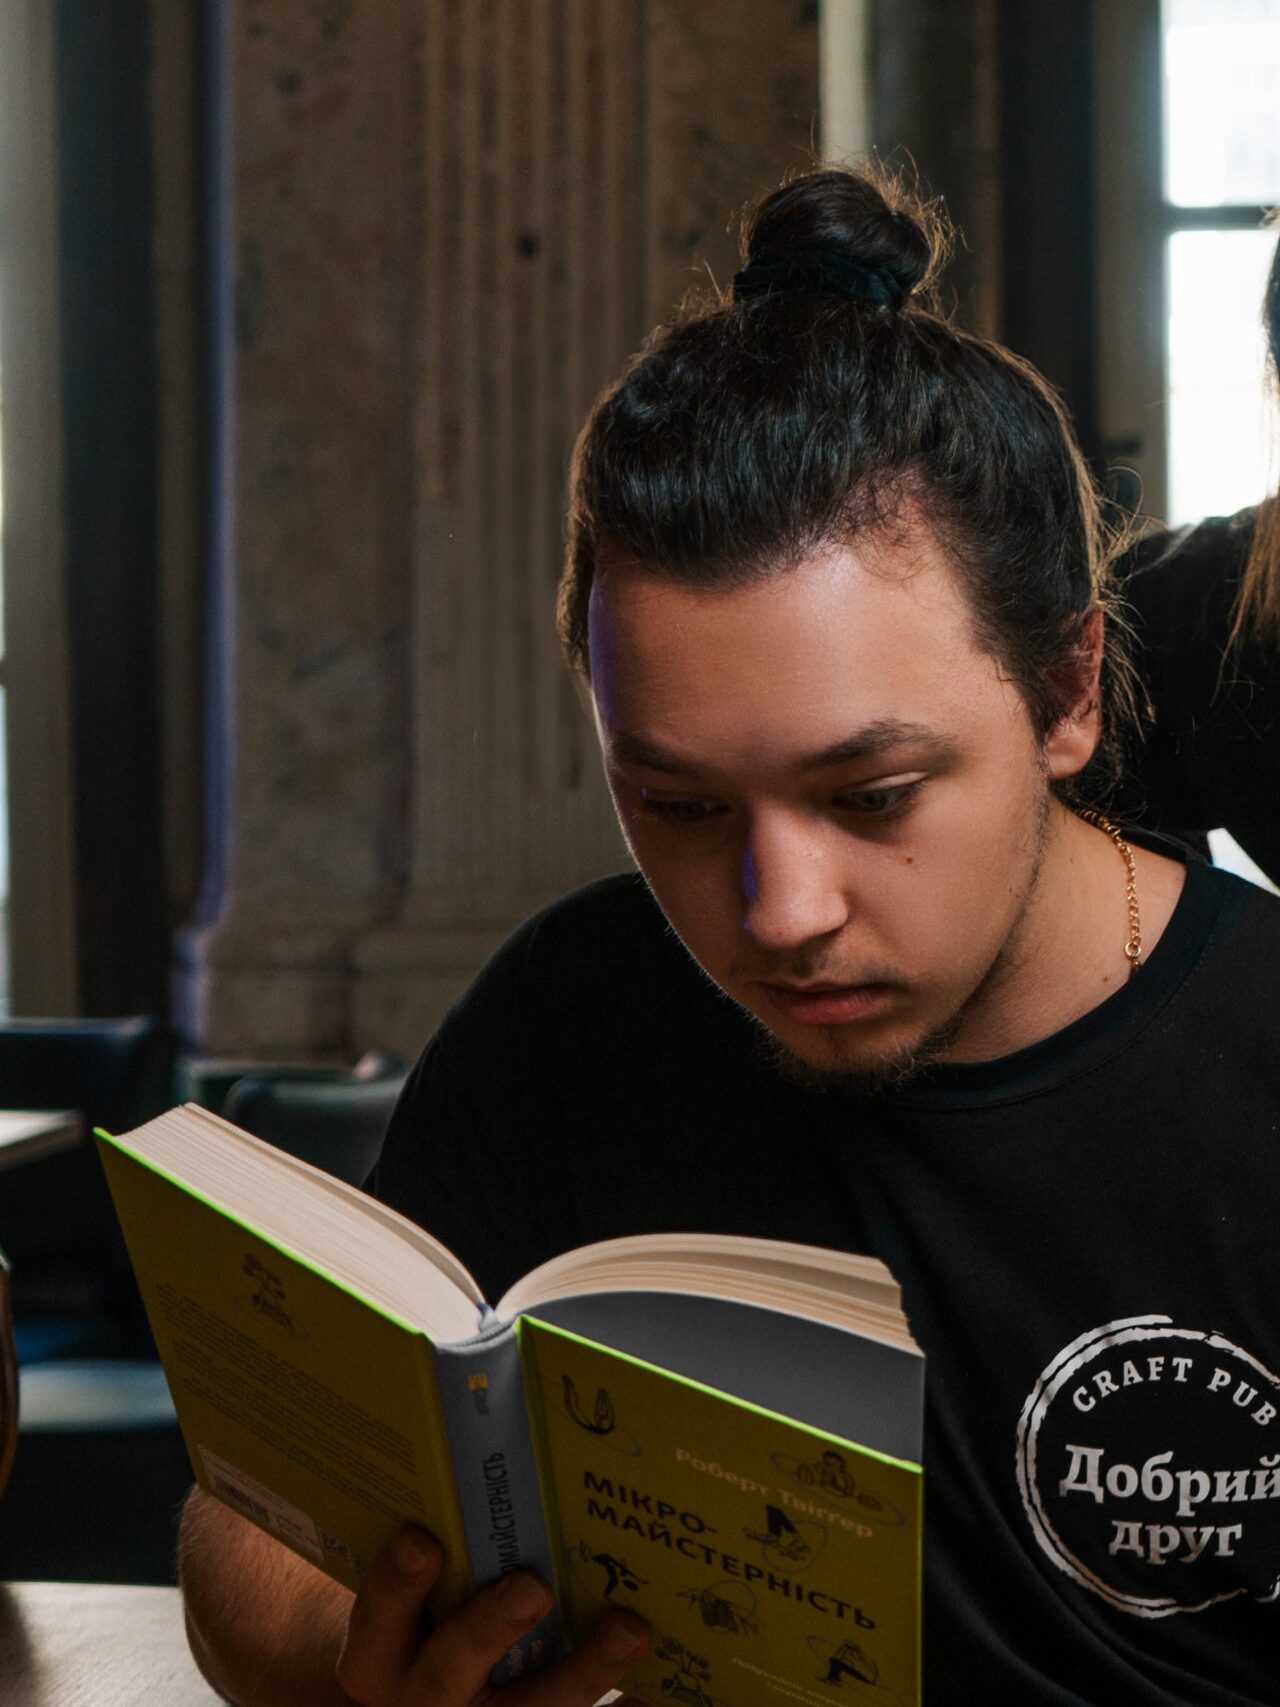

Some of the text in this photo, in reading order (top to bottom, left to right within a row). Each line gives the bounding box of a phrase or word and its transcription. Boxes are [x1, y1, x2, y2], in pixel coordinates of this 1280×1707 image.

[1072, 1356, 1278, 1427] CRAFT PUB
[584, 1470, 718, 1535] МІКРО-
[676, 1448, 771, 1497] Роберт
[482, 1452, 522, 1574] ОМАЙСТЕРНІСТЬ
[1108, 1520, 1243, 1566] друг
[587, 1498, 877, 1631] МАЙСТЕРНІСТЬ
